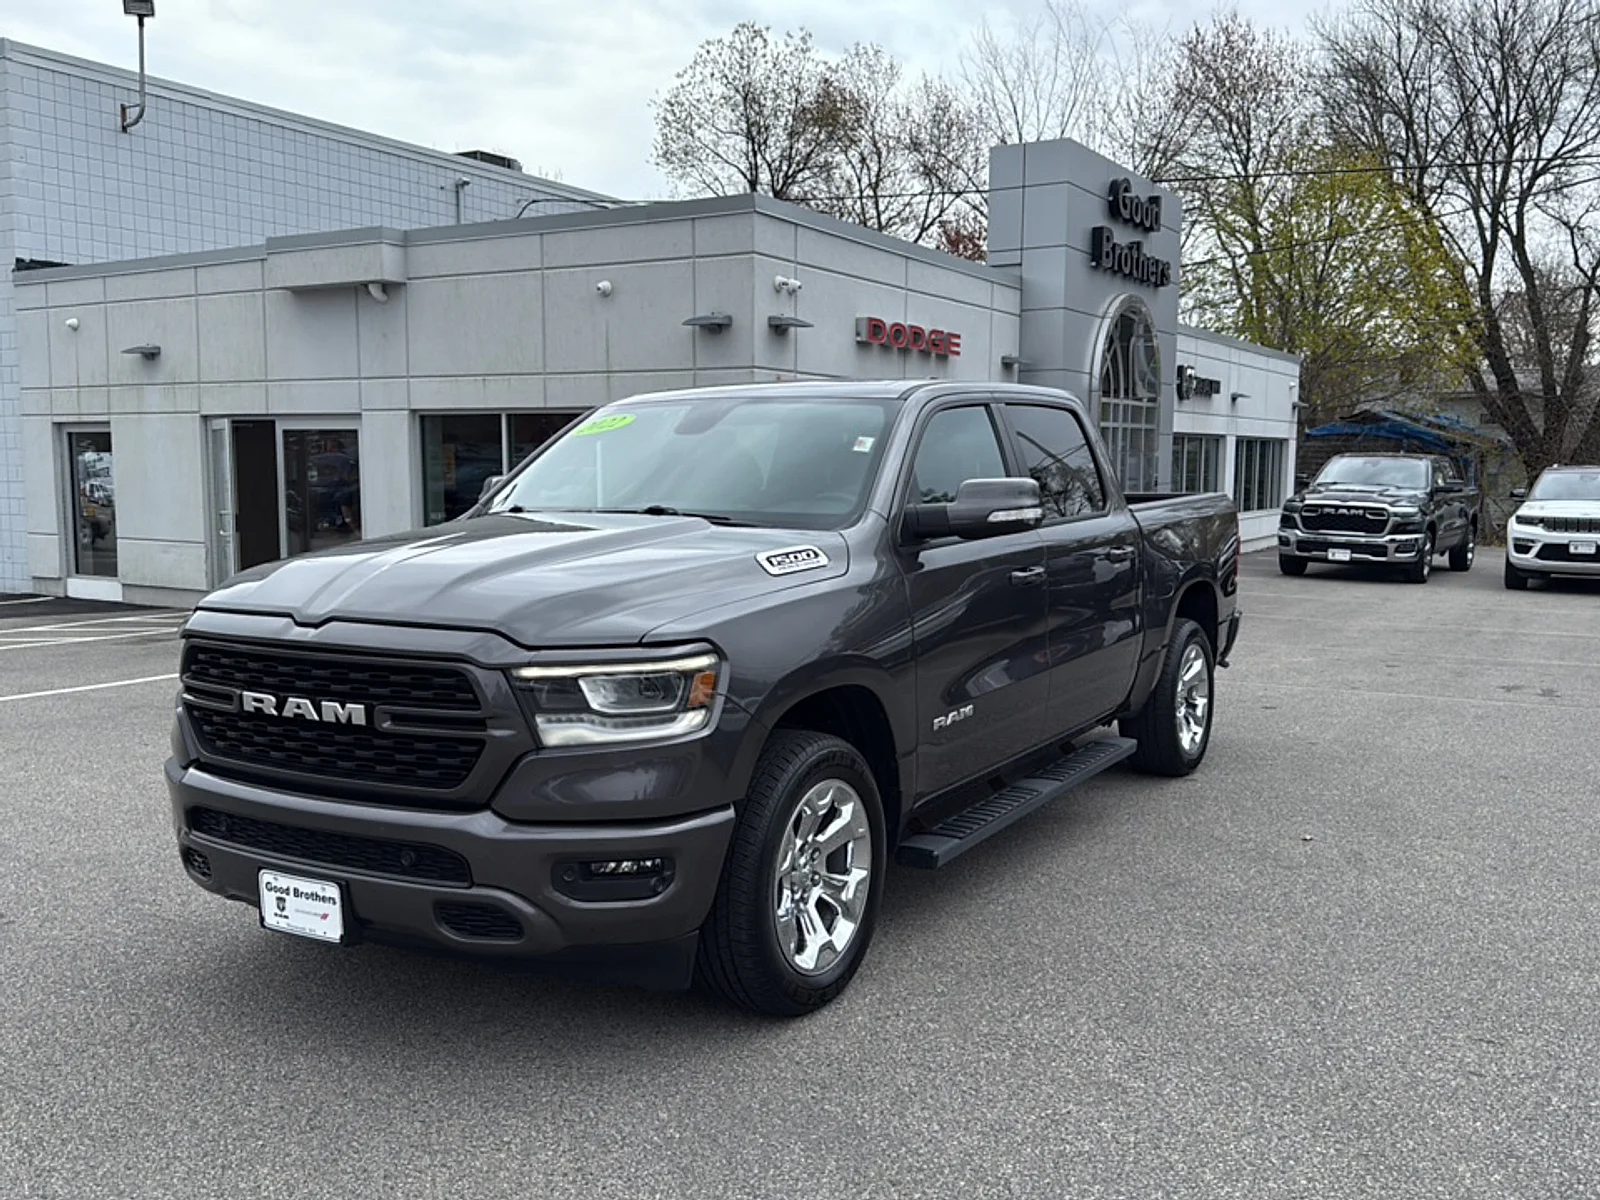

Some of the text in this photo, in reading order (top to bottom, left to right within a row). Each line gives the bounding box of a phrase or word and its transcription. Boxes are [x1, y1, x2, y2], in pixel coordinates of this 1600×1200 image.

[1109, 177, 1162, 232] Good
[1092, 226, 1171, 287] Brothers
[859, 317, 961, 356] DODGE
[1323, 508, 1365, 516] RAM
[768, 549, 818, 566] 1500
[242, 691, 367, 725] RAM
[933, 704, 974, 731] RAM
[265, 881, 337, 906] Good Brothers
